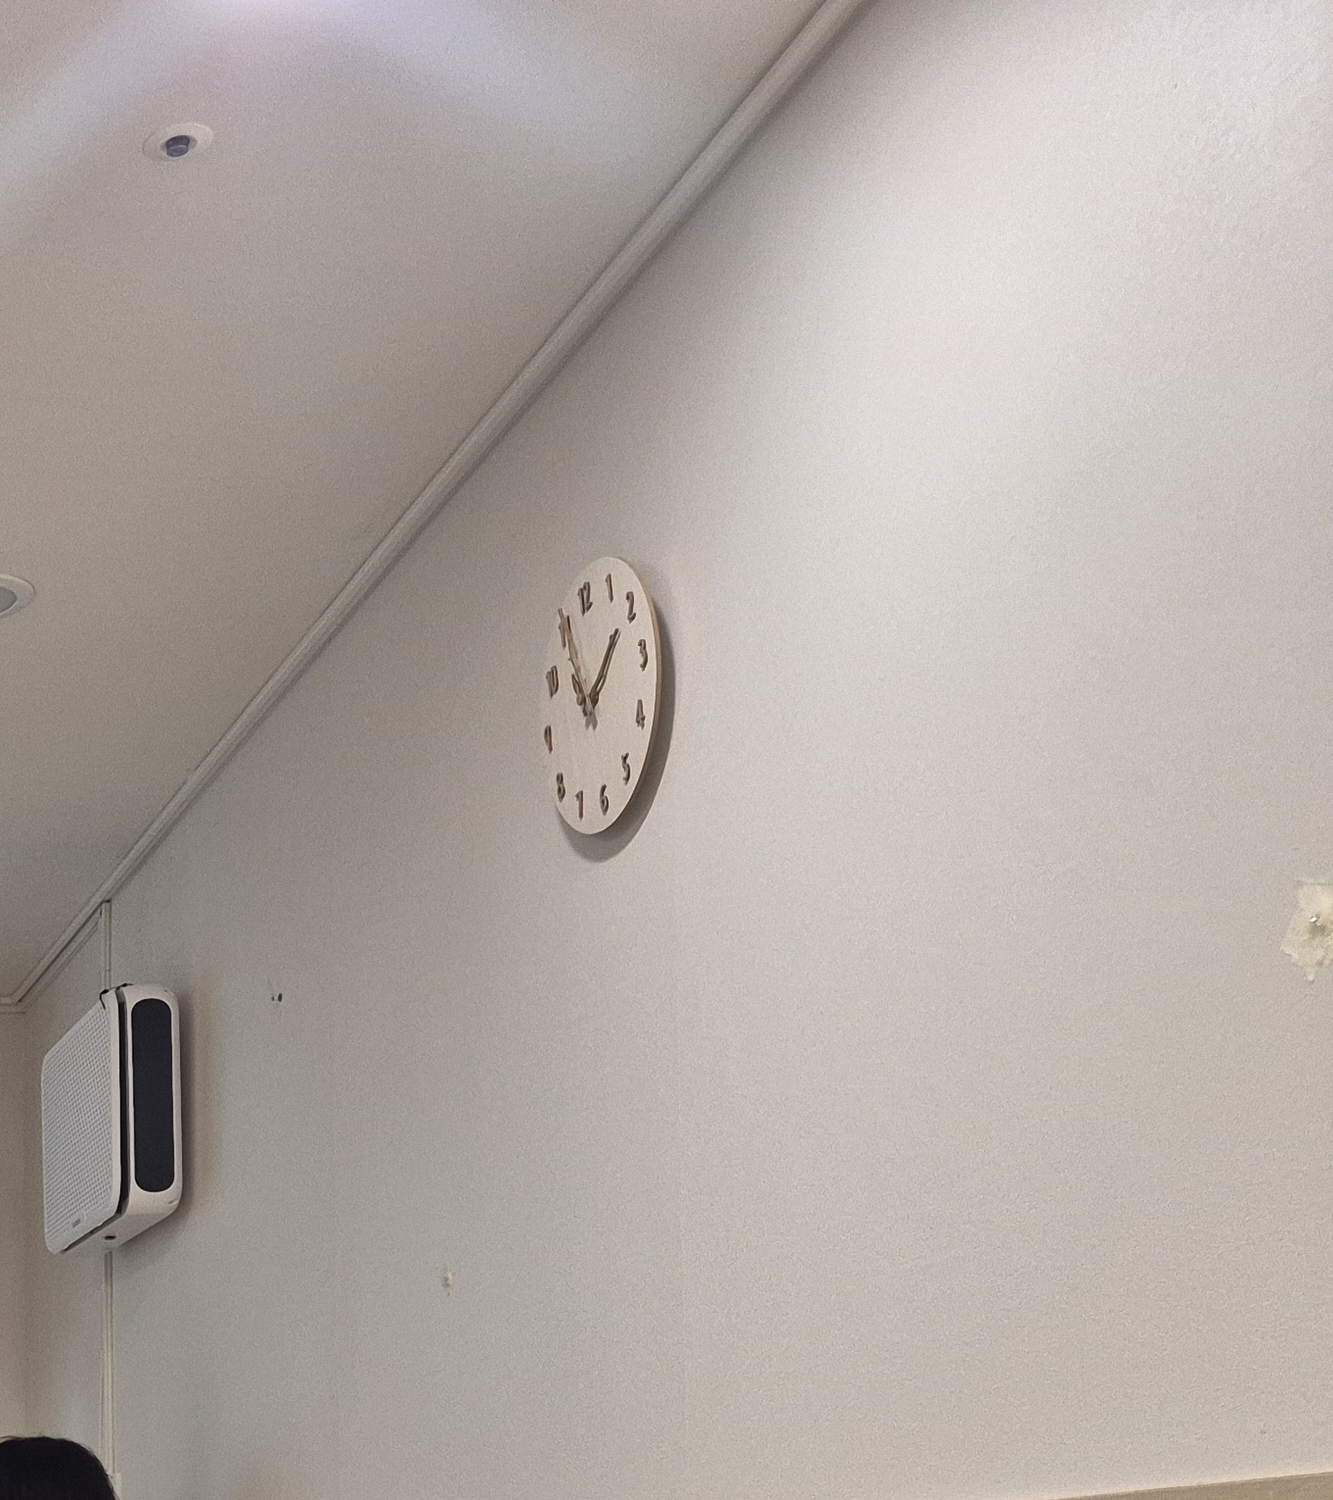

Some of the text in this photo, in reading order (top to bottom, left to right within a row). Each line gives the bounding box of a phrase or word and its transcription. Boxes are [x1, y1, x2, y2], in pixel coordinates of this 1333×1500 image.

[577, 581, 593, 616] 12
[605, 573, 613, 603] 1
[626, 591, 636, 624] 2
[638, 638, 648, 672] 3
[546, 665, 559, 698] 10
[636, 699, 646, 730] 4
[621, 752, 631, 786] 5
[556, 772, 566, 803] 8
[600, 783, 609, 816] 6
